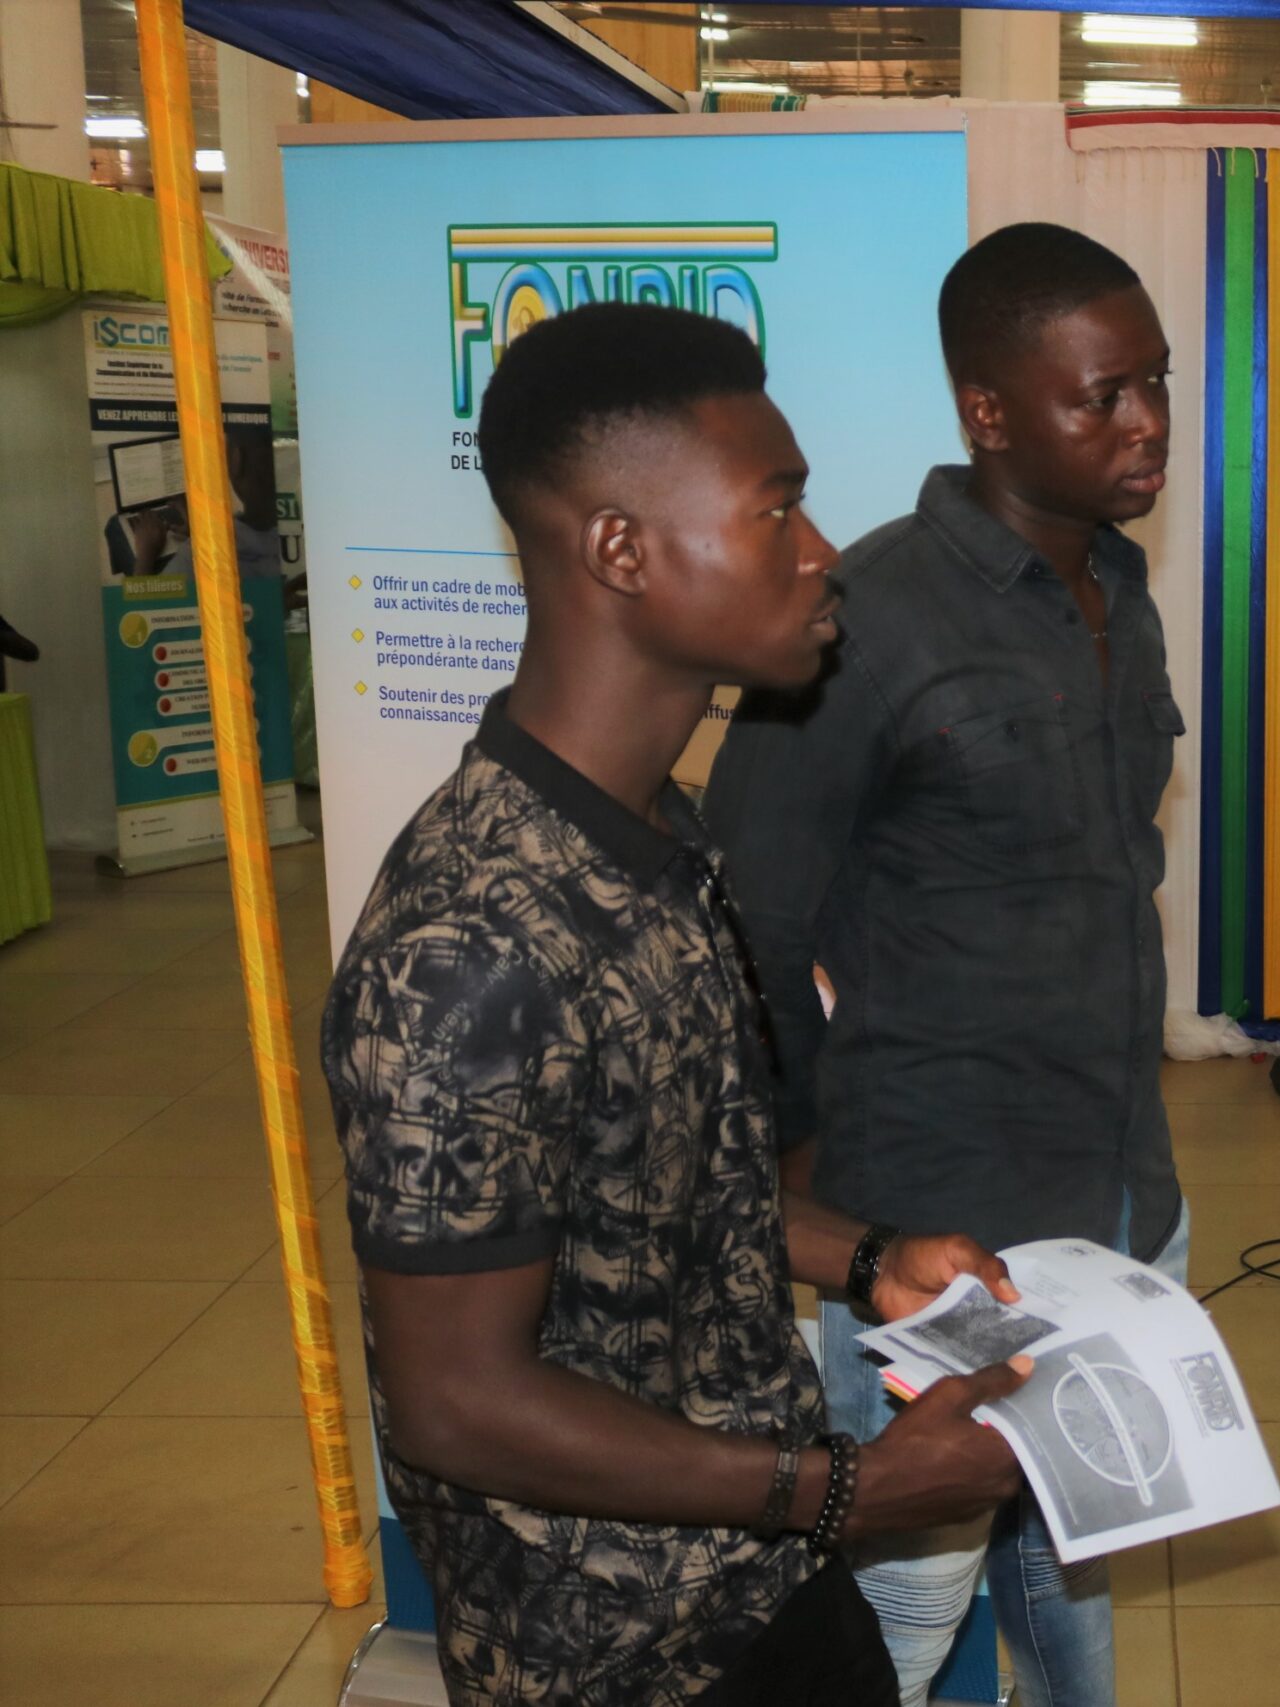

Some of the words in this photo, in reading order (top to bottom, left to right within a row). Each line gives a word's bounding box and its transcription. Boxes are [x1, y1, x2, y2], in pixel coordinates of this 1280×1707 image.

[451, 455, 471, 470] DE
[373, 575, 408, 593] Offrir
[412, 580, 428, 593] un
[433, 577, 471, 594] cadre
[475, 578, 492, 596] de
[374, 598, 398, 611] aux
[401, 595, 459, 613] activités
[462, 597, 479, 614] de
[376, 631, 443, 650] Permettre
[447, 634, 457, 650] à
[459, 634, 473, 651] la
[377, 650, 478, 671] prépondérante
[481, 654, 516, 671] dans
[379, 686, 438, 704] Soutenir
[440, 689, 465, 705] des
[380, 706, 481, 725] connaissances
